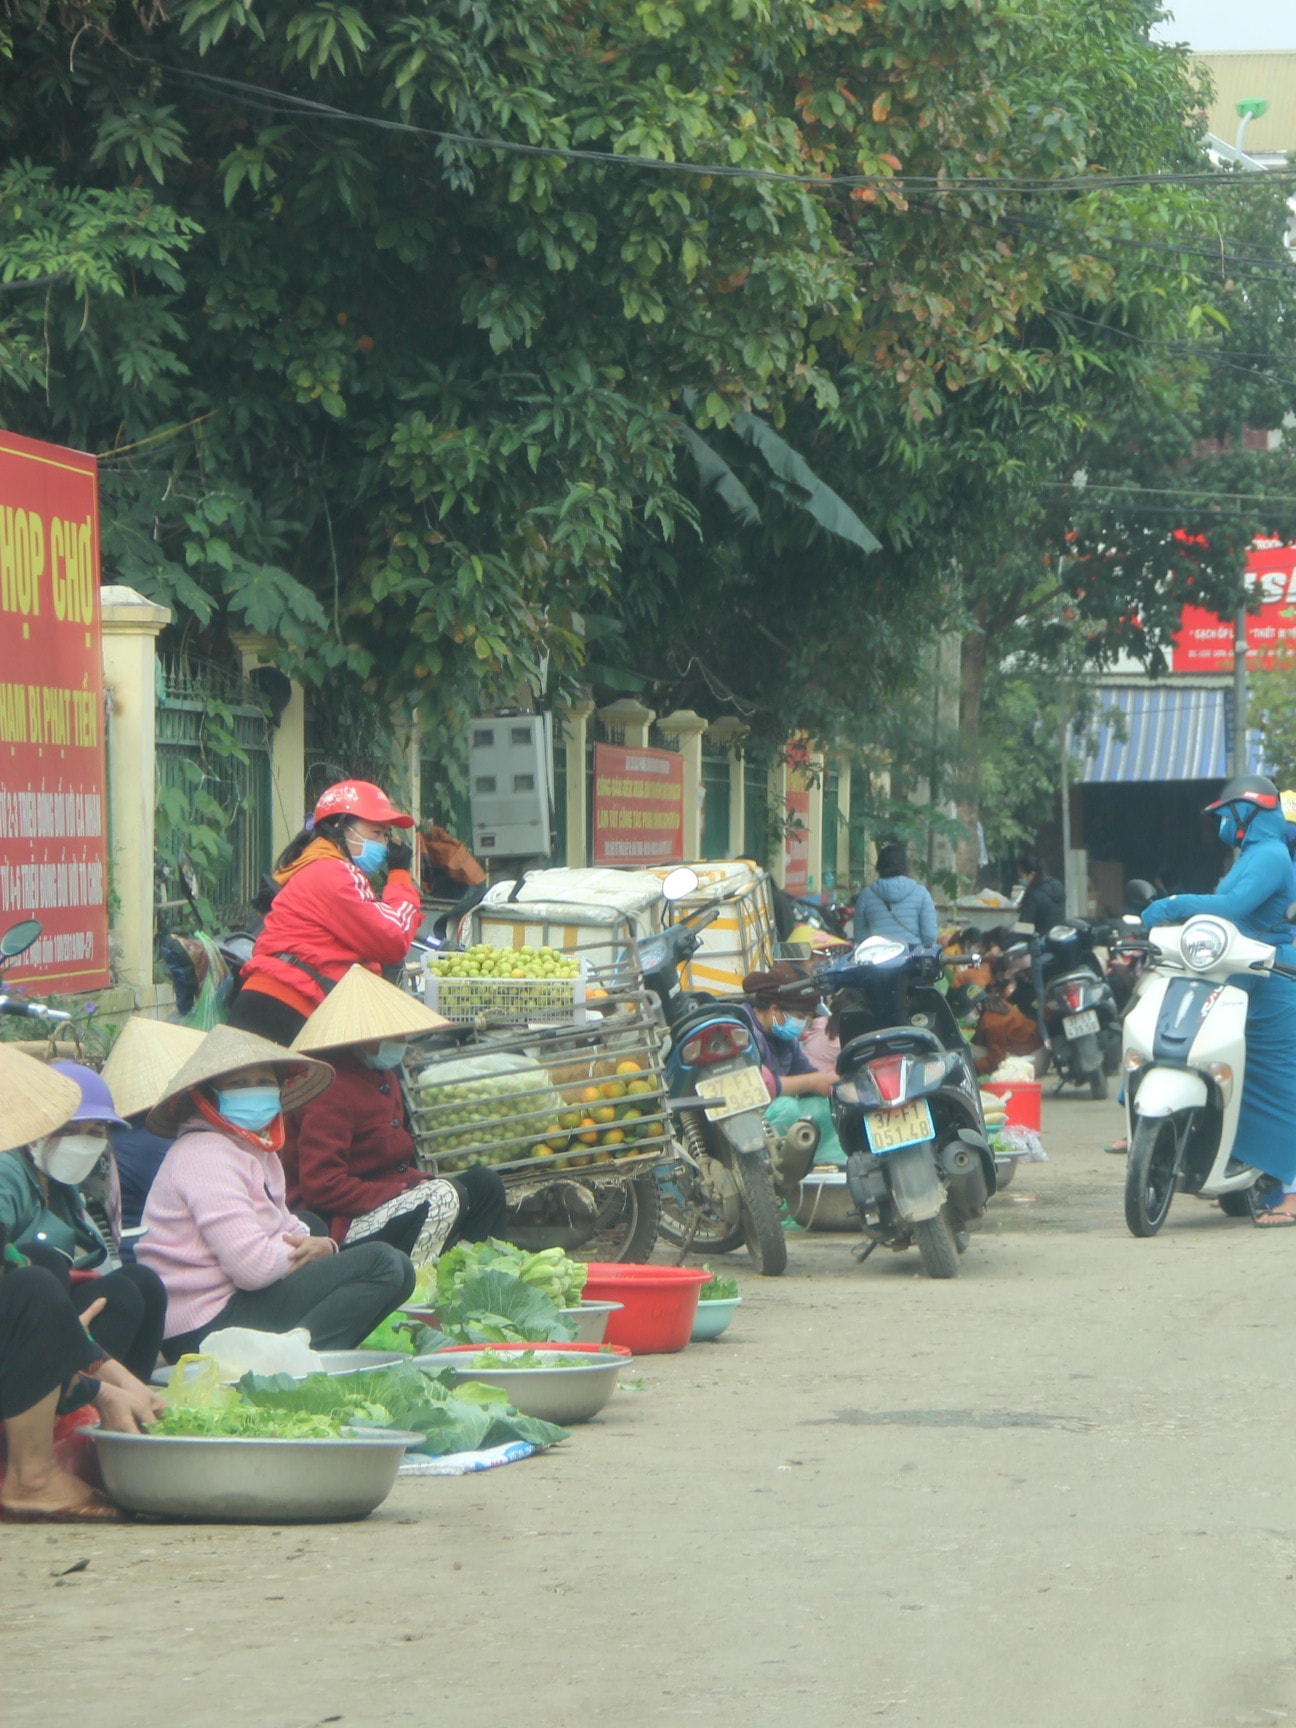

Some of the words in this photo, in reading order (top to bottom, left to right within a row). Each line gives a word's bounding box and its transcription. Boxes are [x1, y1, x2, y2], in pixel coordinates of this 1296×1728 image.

[51, 514, 93, 648] CHỢ
[28, 684, 43, 758] BỊ
[43, 686, 71, 760] PHẠT
[7, 792, 19, 838] 2-3
[874, 1103, 920, 1129] 37-F1
[874, 1120, 930, 1148] 051.48
